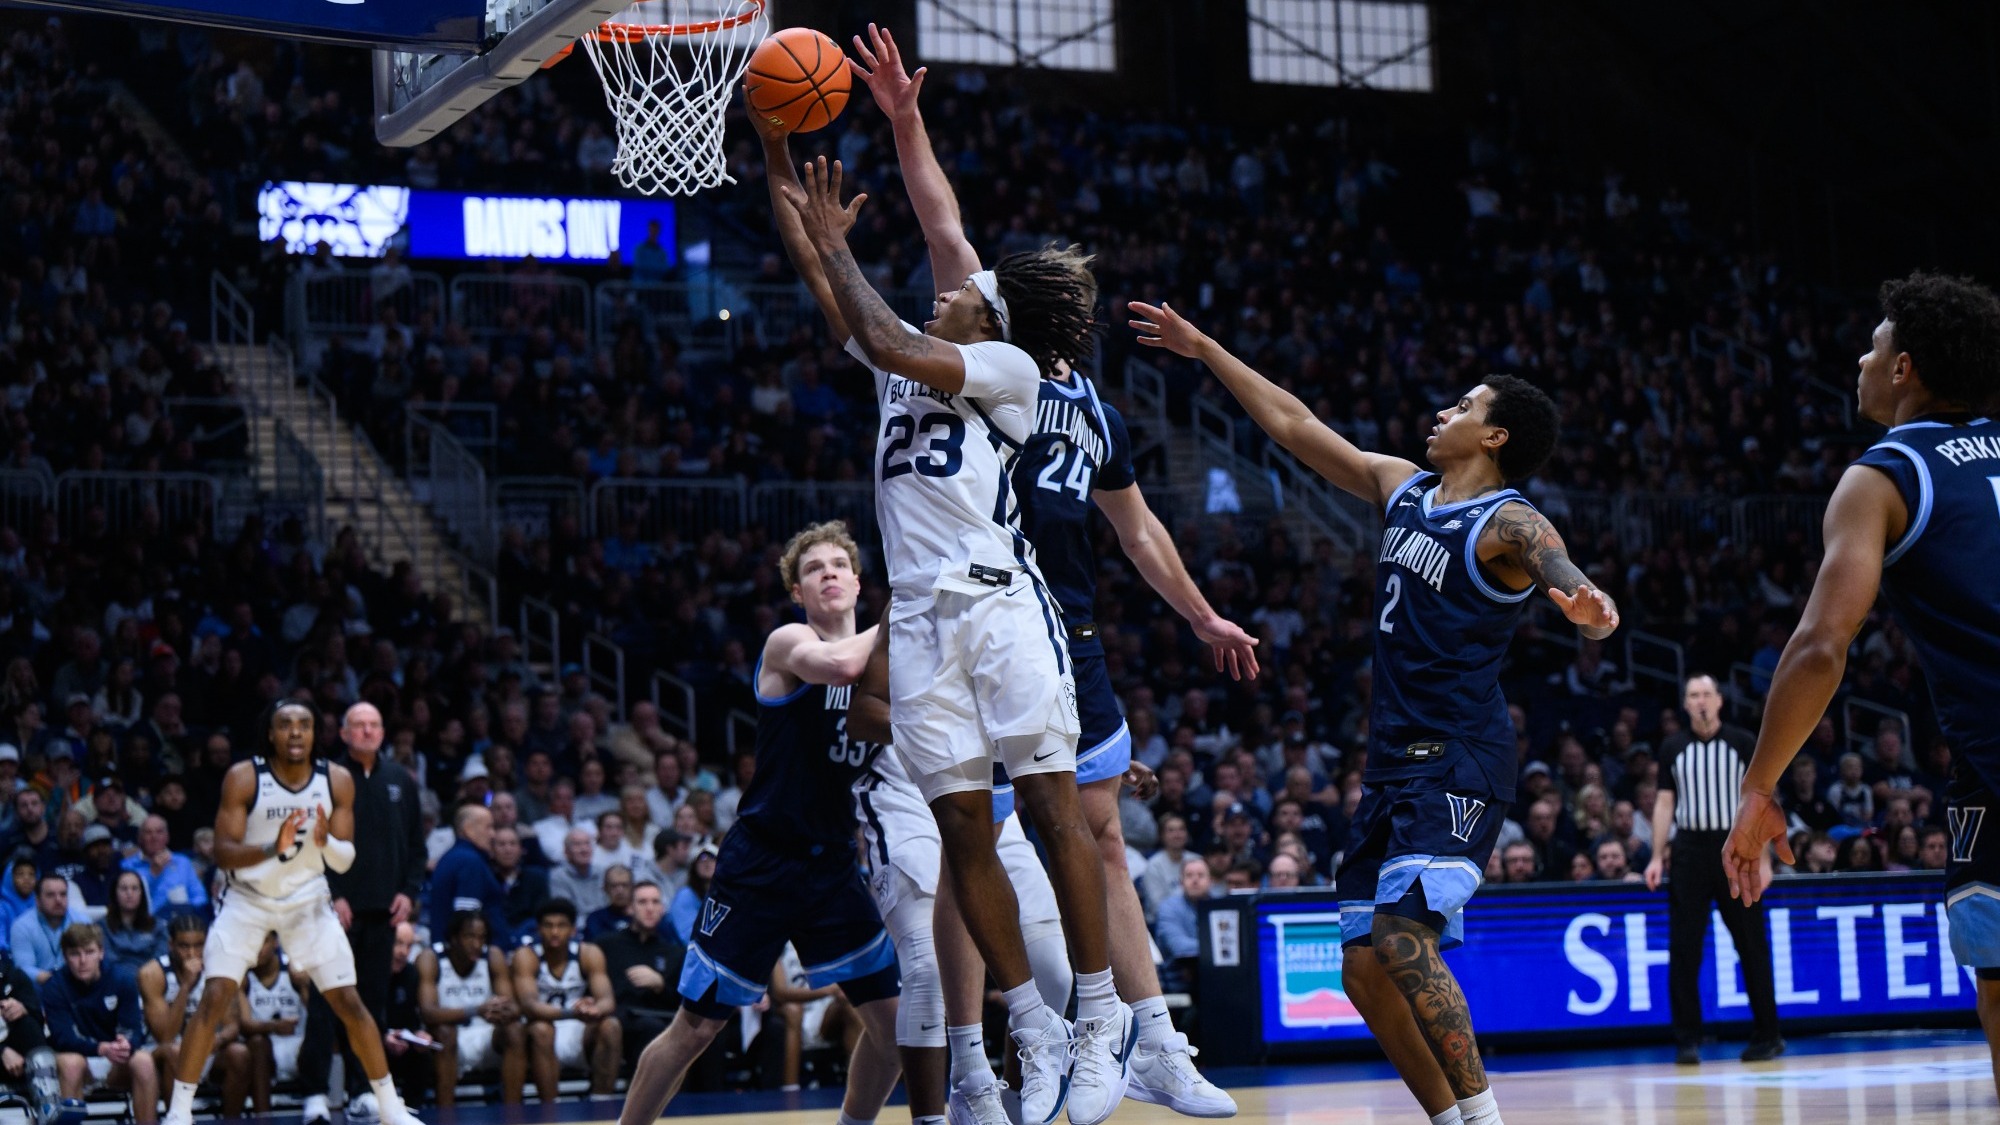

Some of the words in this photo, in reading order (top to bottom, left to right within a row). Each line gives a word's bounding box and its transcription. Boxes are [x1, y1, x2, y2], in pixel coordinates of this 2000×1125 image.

[882, 412, 965, 482] 23
[1037, 441, 1092, 503] 24
[1935, 436, 2000, 466] PERKI
[1380, 573, 1401, 634] 2
